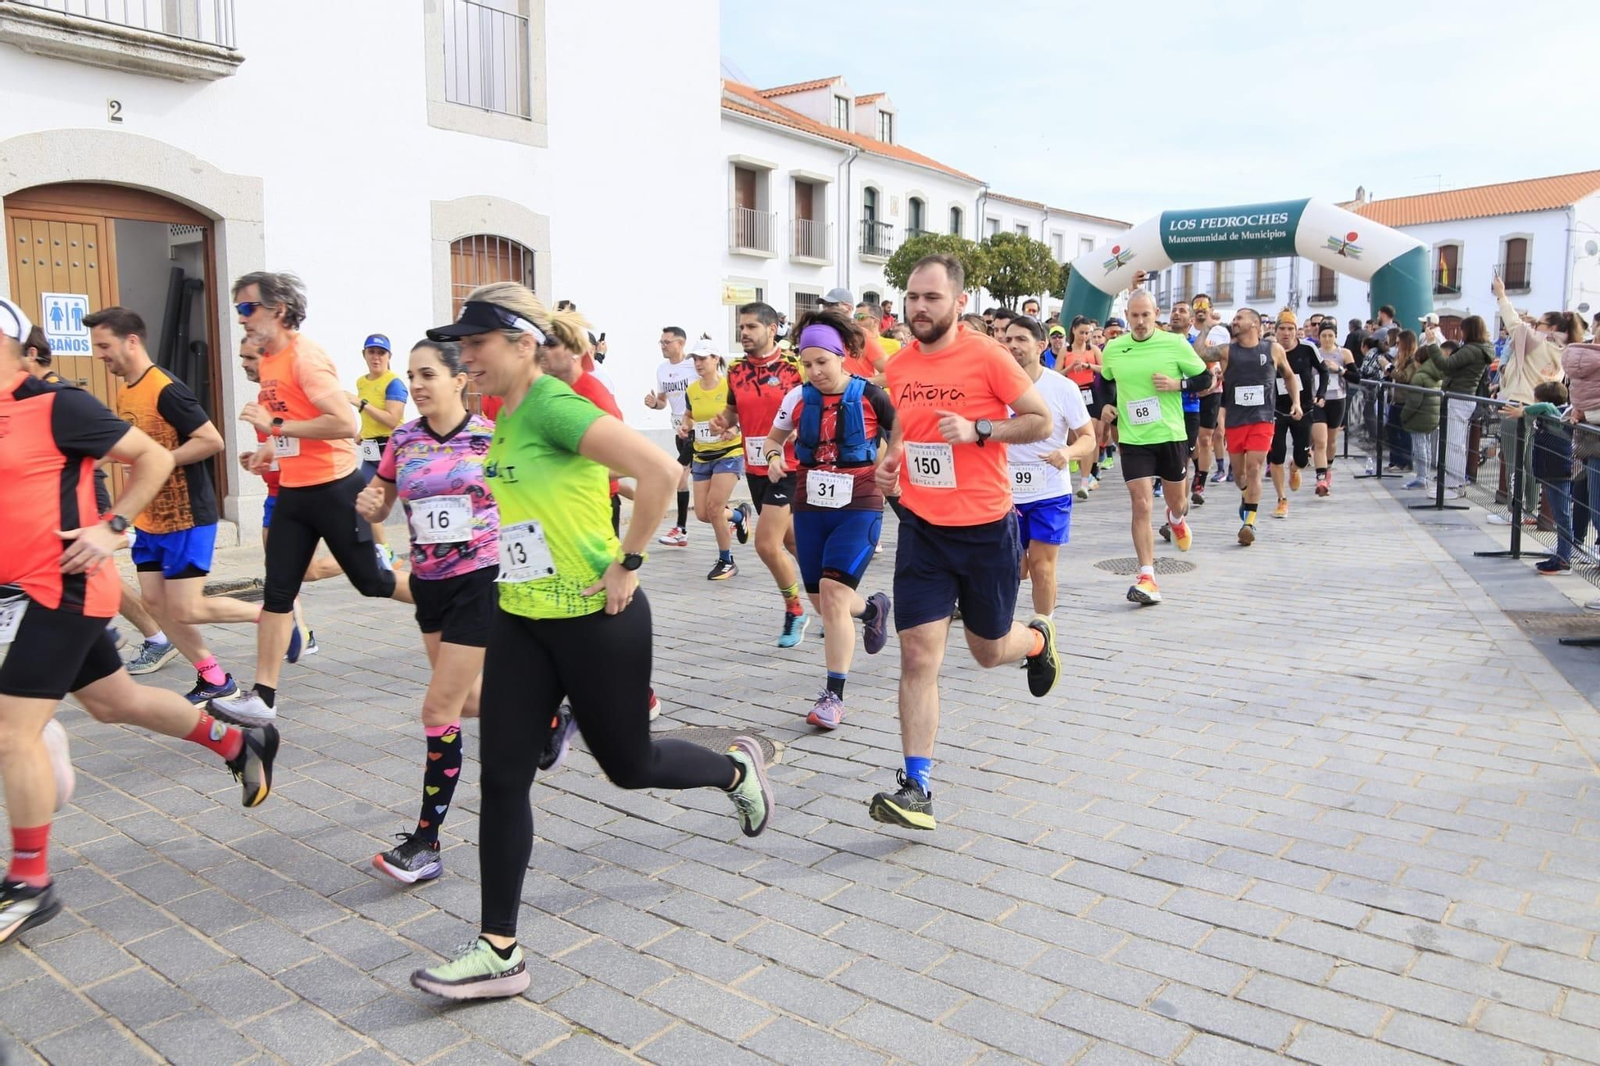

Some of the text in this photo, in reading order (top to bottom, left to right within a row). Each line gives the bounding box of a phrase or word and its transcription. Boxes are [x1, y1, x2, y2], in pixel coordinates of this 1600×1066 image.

[110, 100, 123, 121] 2
[1169, 212, 1289, 231] LOS PEDROCHES
[1168, 228, 1287, 244] Mancomunidad de Municipios
[48, 336, 90, 352] BAÑOS
[1243, 392, 1254, 401] 57
[1136, 407, 1150, 418] 68
[914, 457, 941, 475] 150
[1015, 471, 1032, 484] 99
[818, 482, 836, 498] 31
[426, 511, 450, 529] 16
[506, 542, 527, 566] 13
